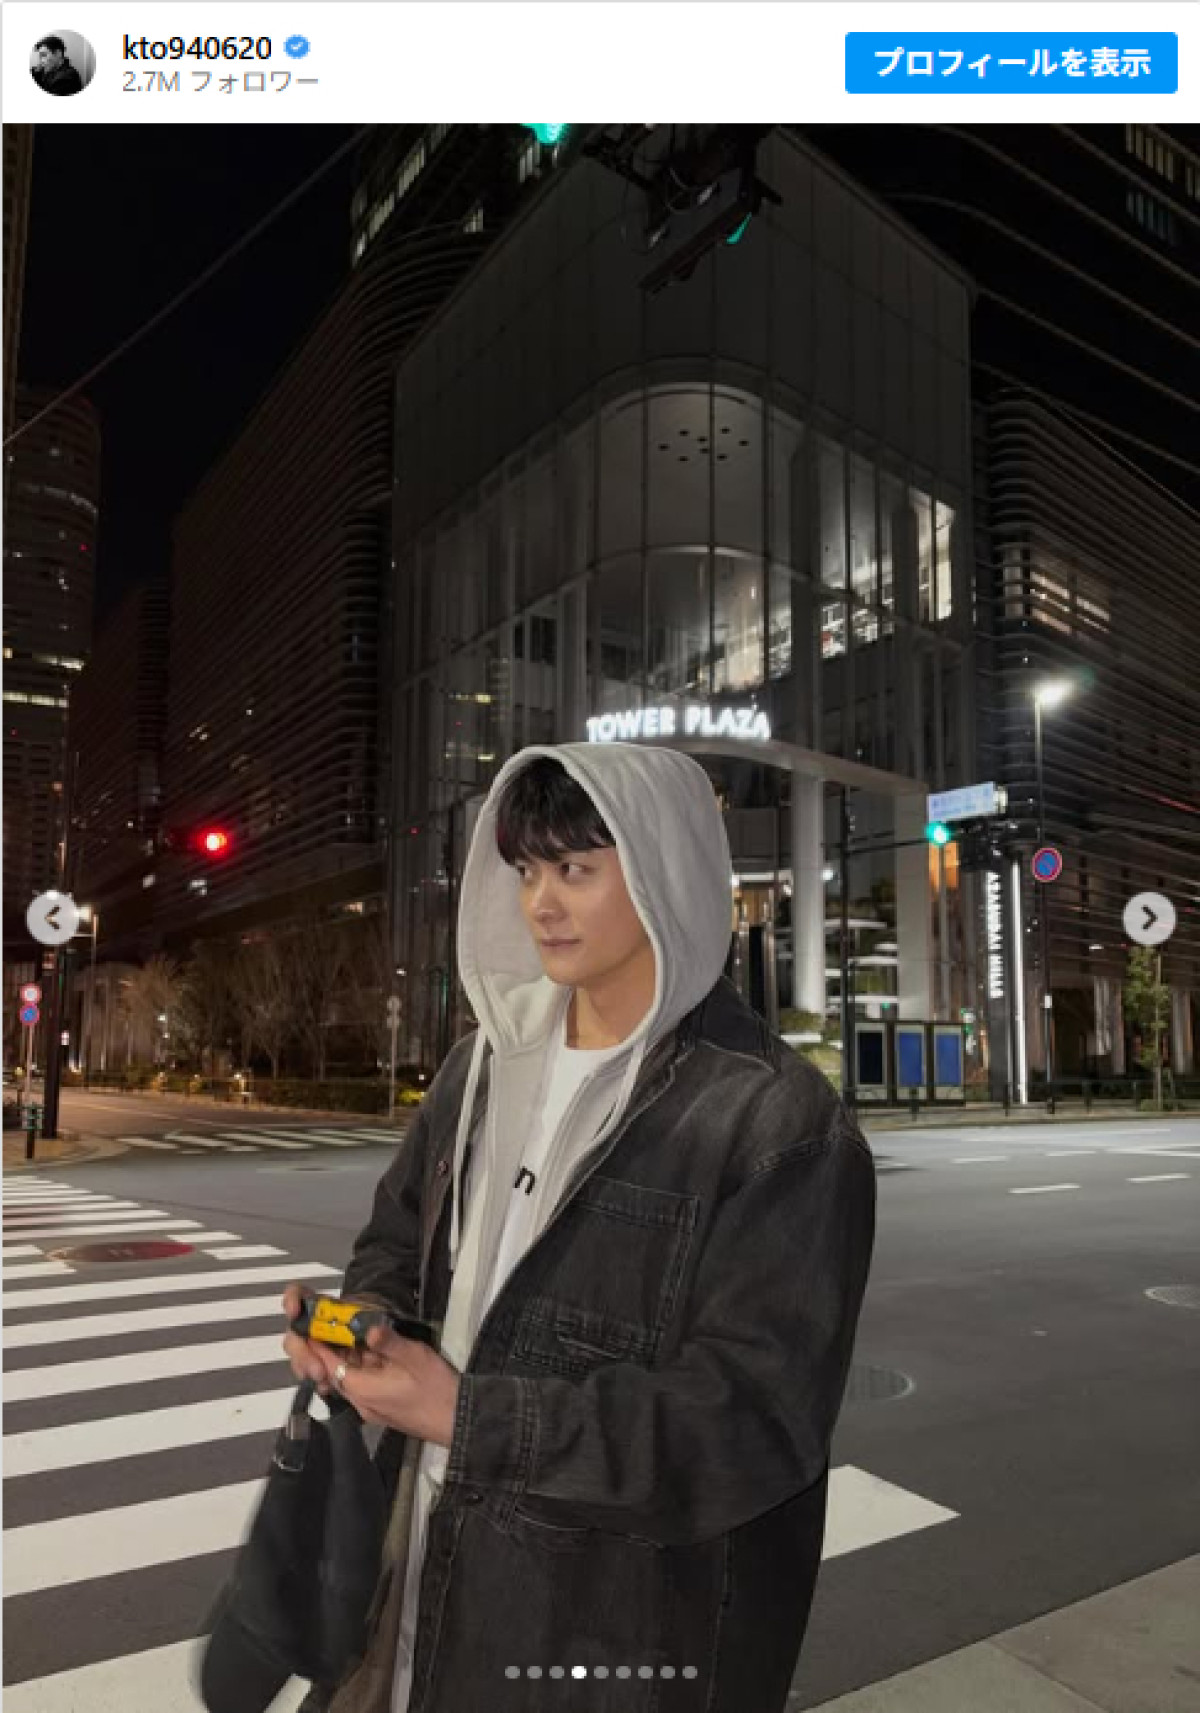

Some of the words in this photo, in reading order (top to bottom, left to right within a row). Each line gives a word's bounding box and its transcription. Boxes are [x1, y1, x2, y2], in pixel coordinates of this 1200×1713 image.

[586, 706, 676, 743] TOWER
[684, 704, 771, 742] PLAZA
[513, 1166, 536, 1195] n
